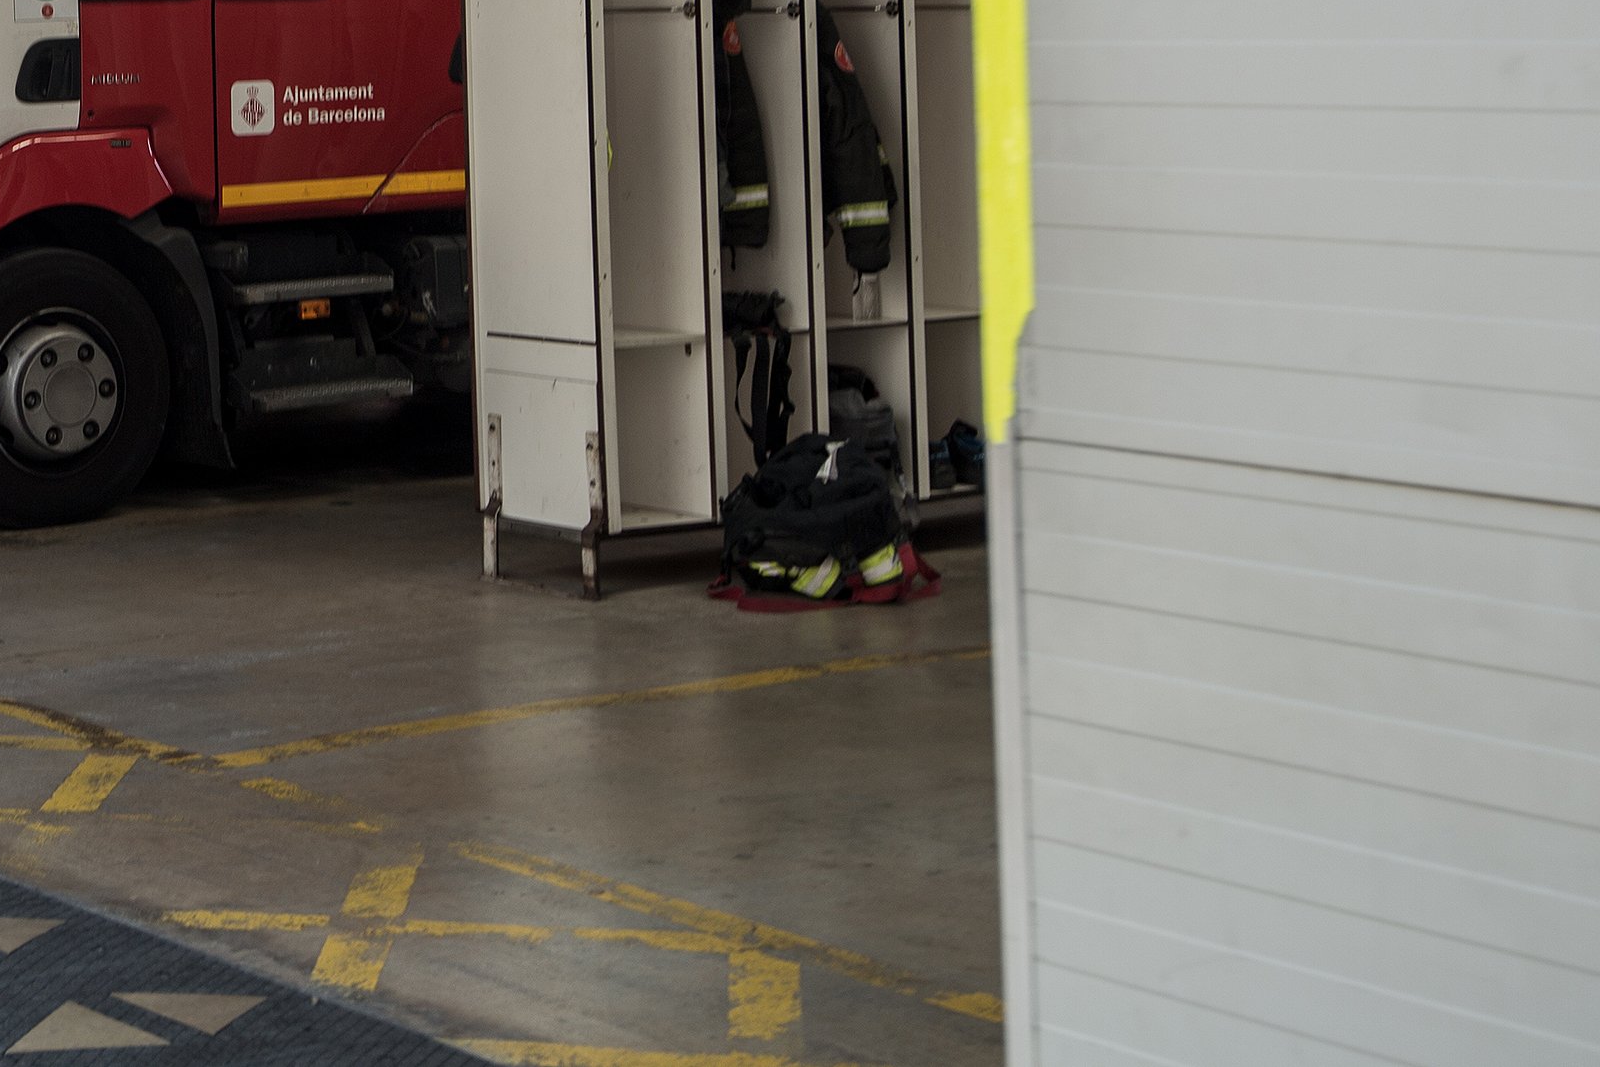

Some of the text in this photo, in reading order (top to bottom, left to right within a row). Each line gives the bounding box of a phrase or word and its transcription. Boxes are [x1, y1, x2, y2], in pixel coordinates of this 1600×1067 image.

[282, 82, 374, 107] Ajuntament
[282, 104, 386, 126] de Barcelona
